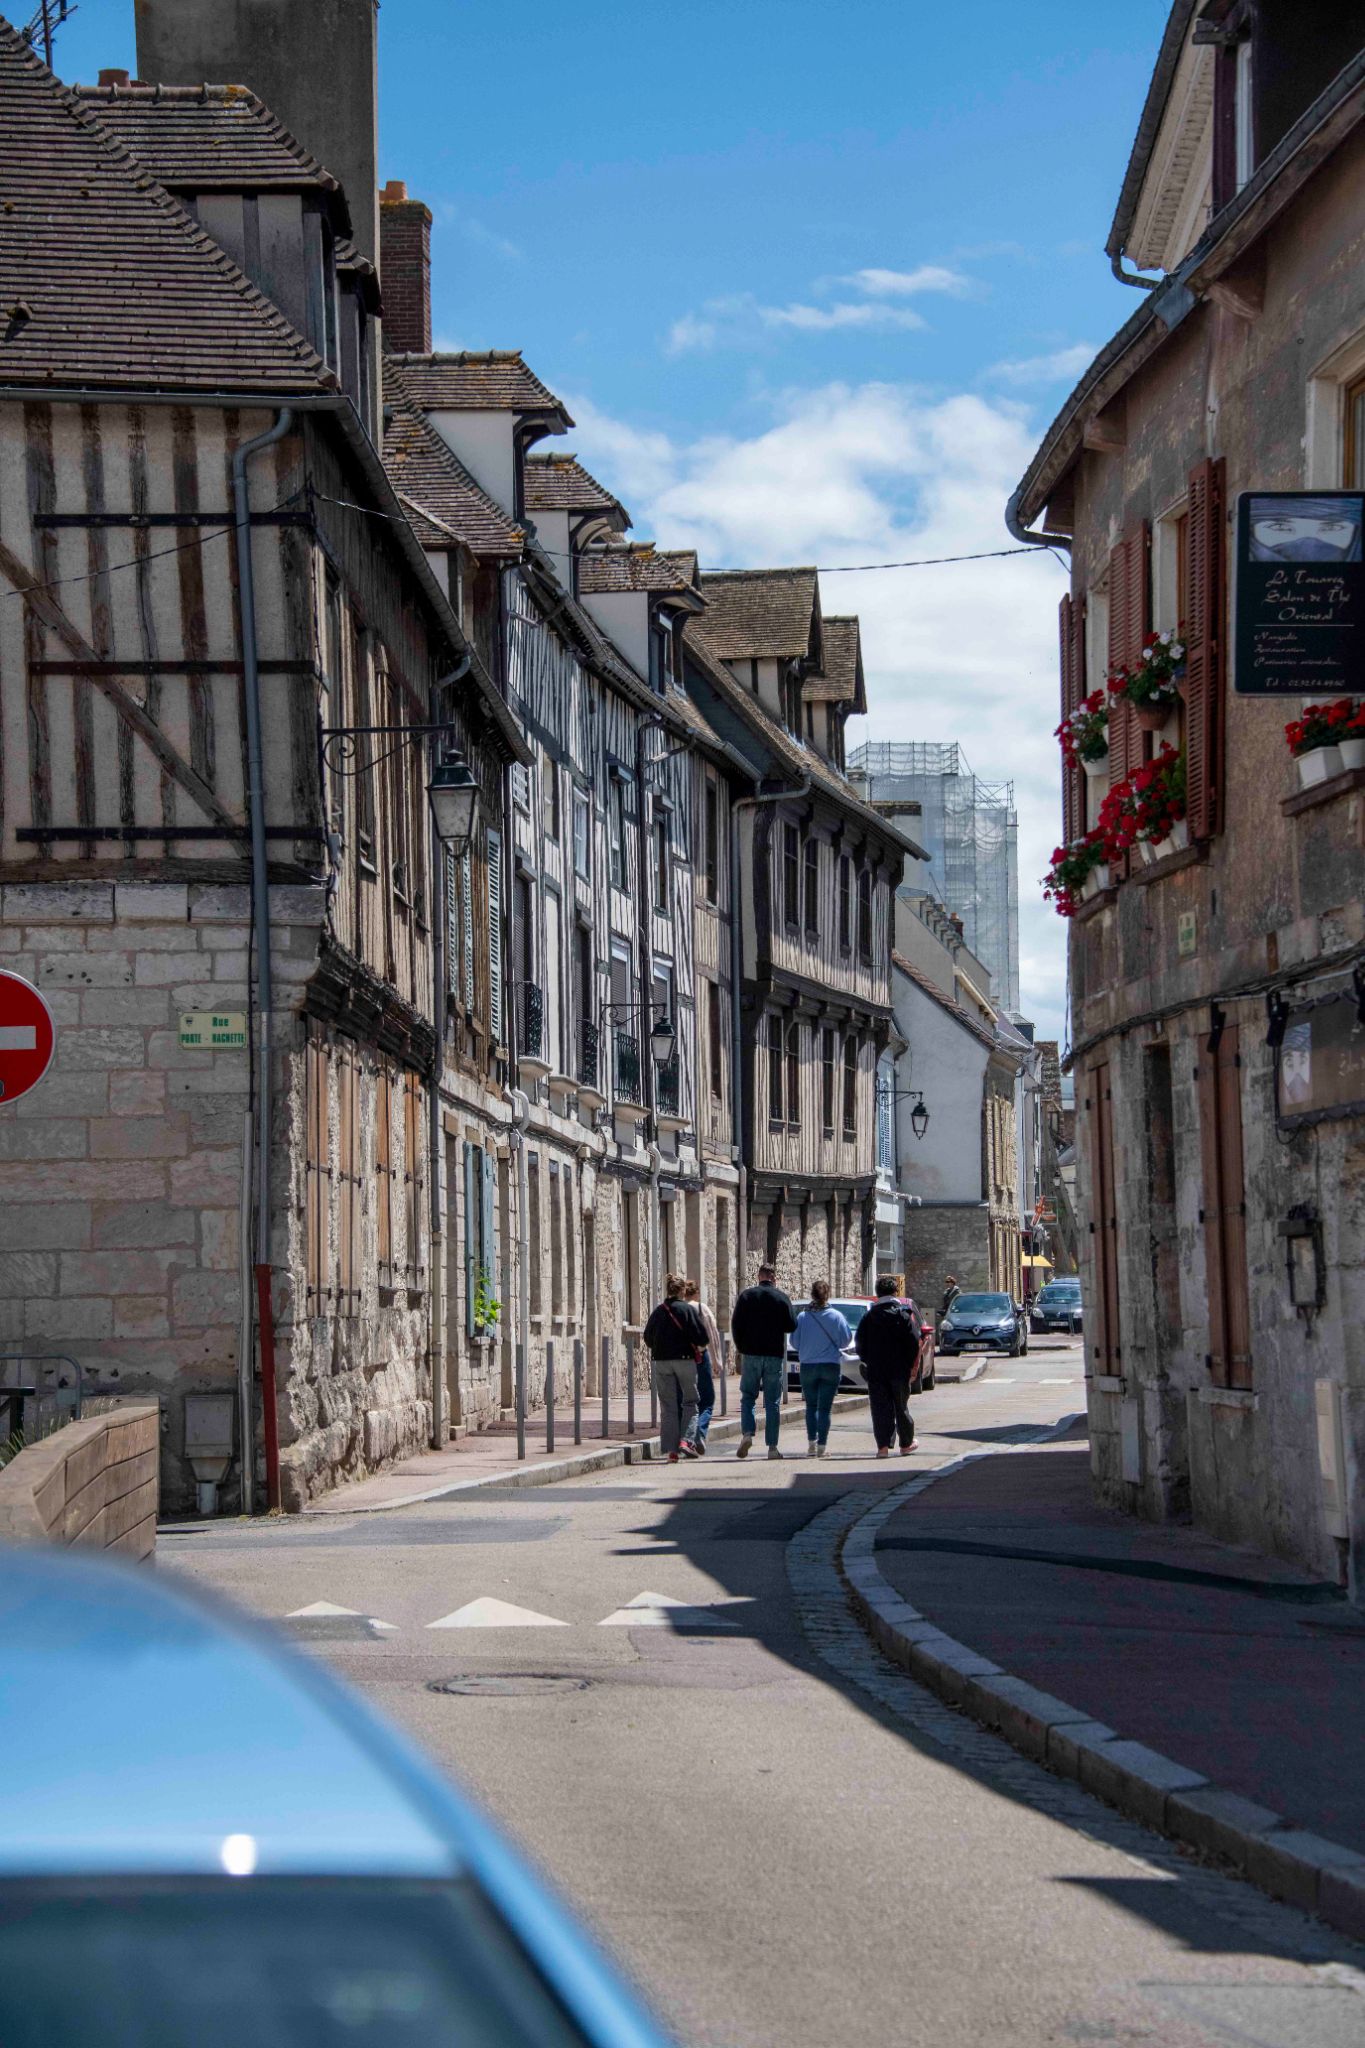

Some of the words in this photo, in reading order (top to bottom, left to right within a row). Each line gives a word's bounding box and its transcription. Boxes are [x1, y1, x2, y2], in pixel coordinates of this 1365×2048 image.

[1265, 570, 1289, 587] Le
[1294, 569, 1345, 590] Touareg
[1263, 589, 1305, 604] Salon
[1309, 593, 1321, 602] de
[1327, 589, 1351, 606] Thé
[1278, 607, 1334, 621] Oriental
[212, 1017, 229, 1027] Rue
